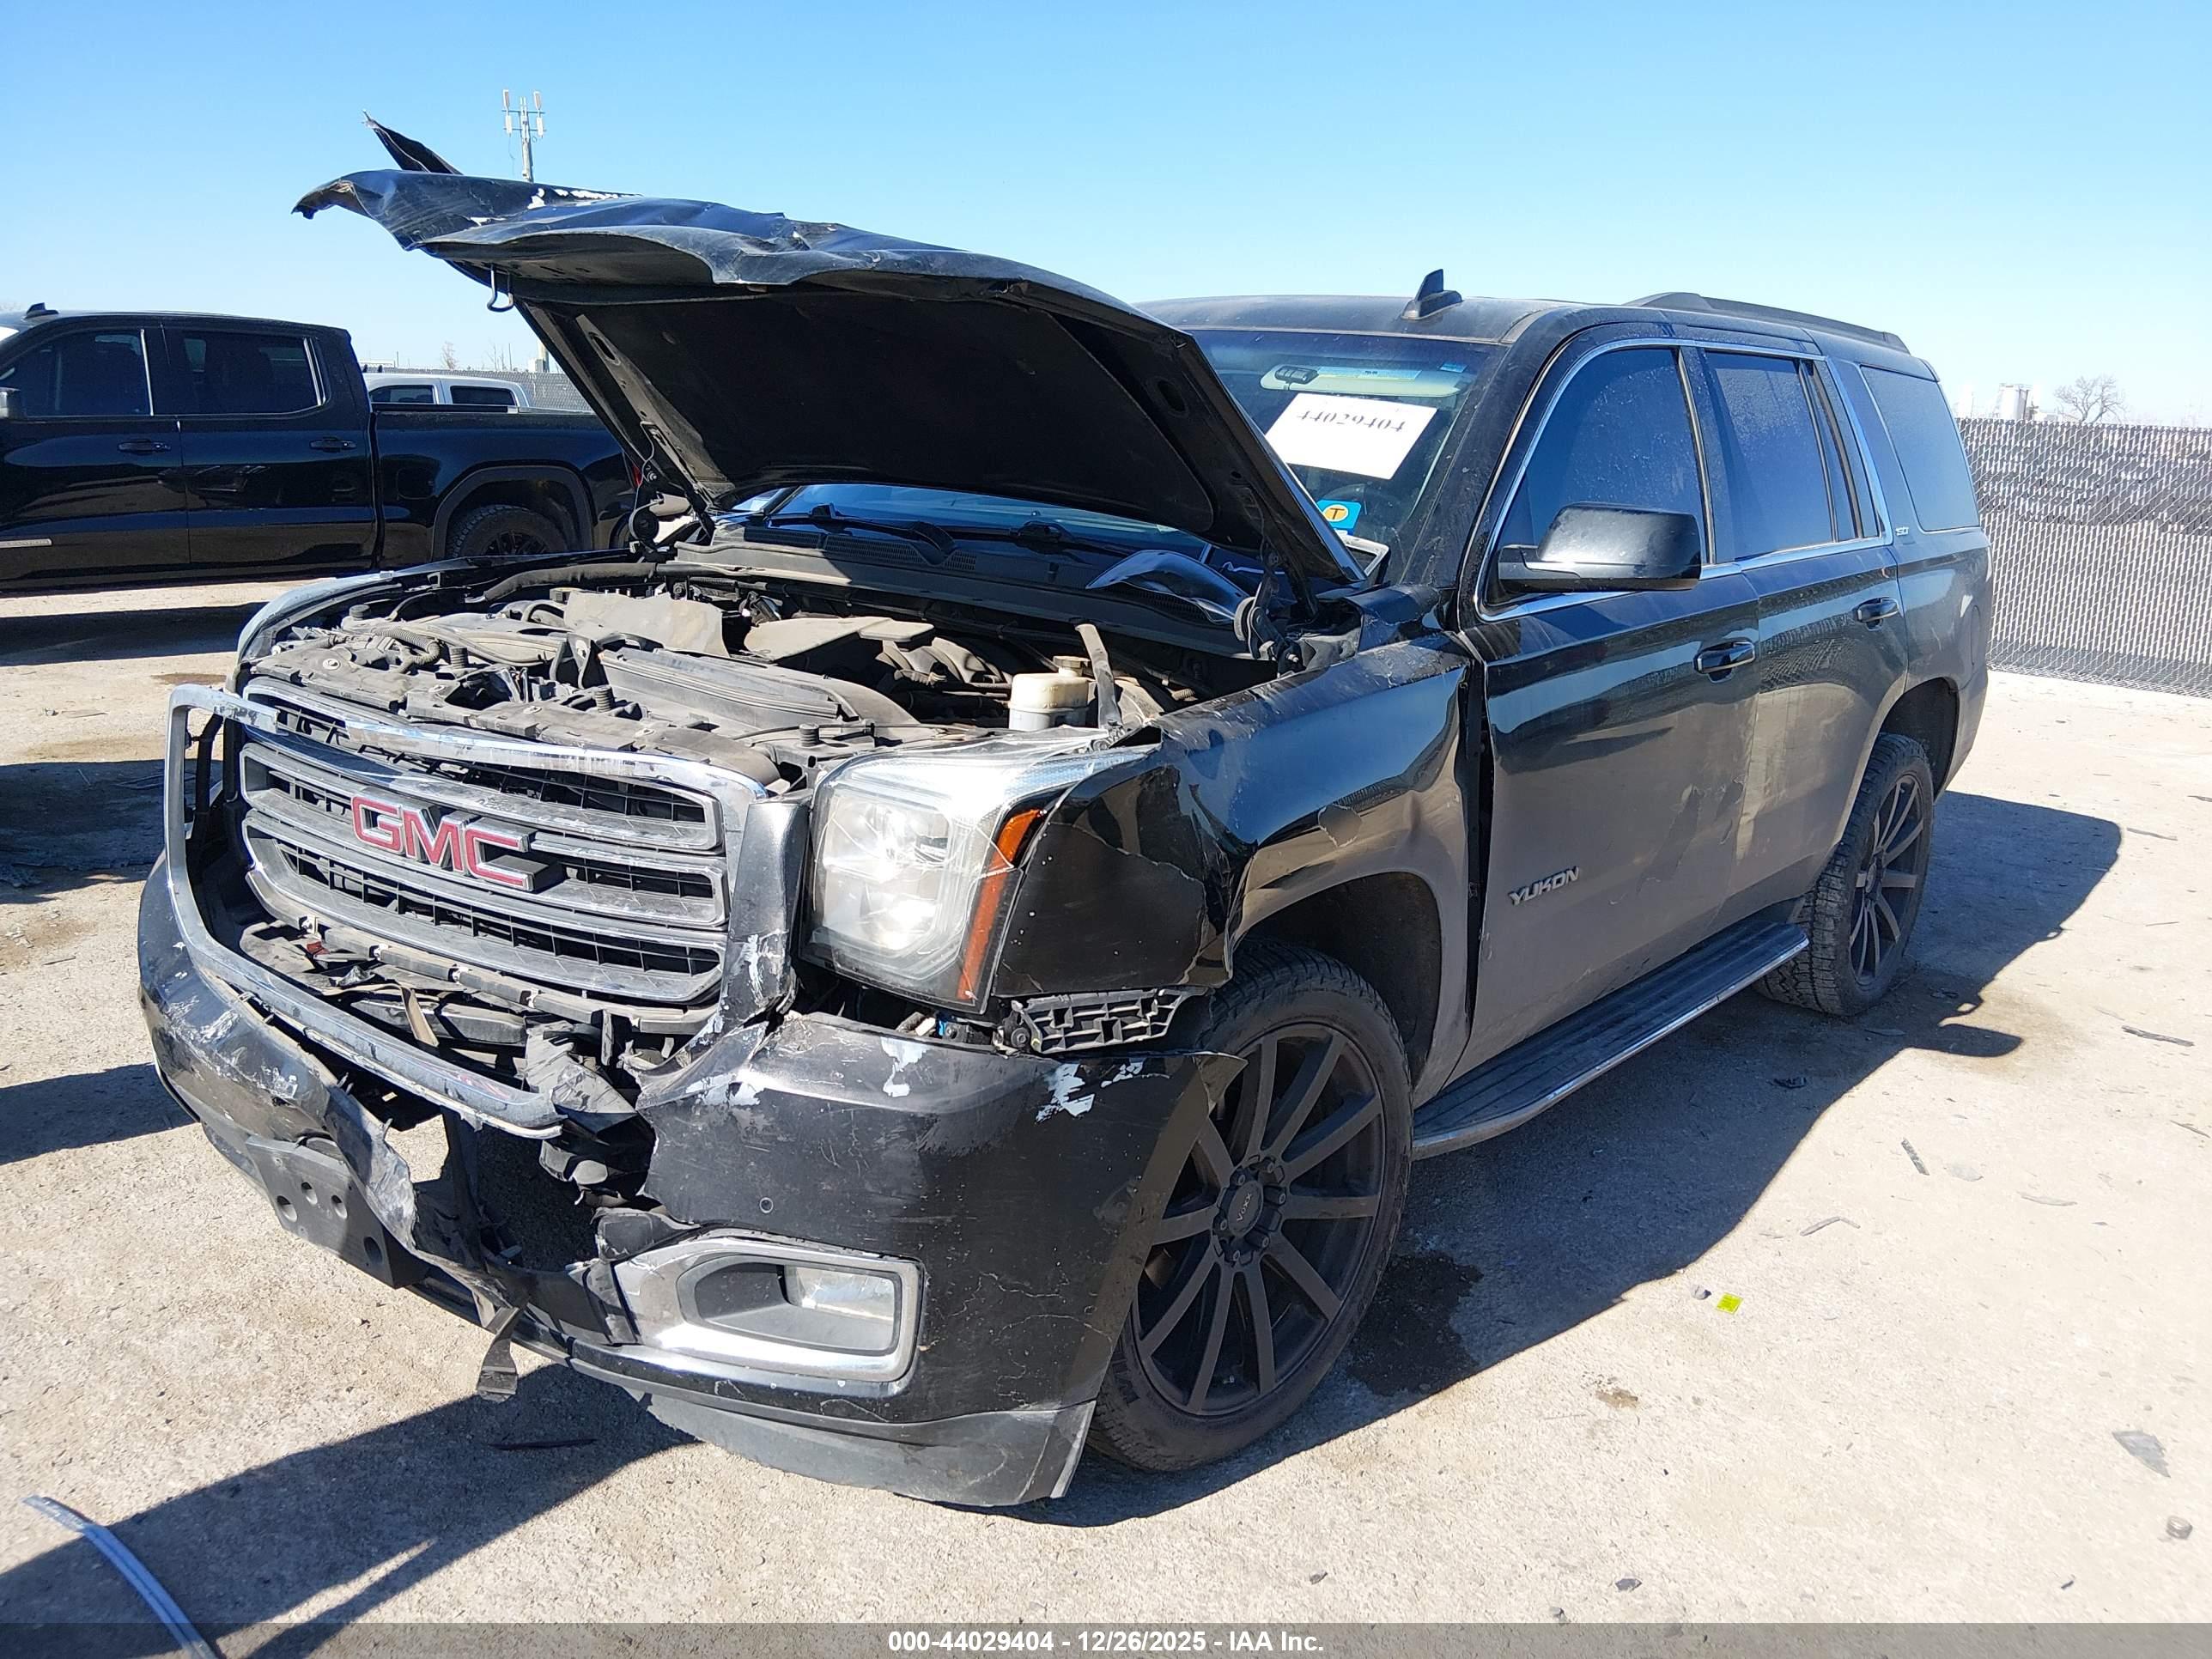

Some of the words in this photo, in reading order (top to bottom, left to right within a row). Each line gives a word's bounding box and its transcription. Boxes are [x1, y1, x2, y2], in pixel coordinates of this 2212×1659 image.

[1329, 507, 1346, 520] T
[351, 794, 534, 891] GMC
[1509, 866, 1579, 906] YUKON
